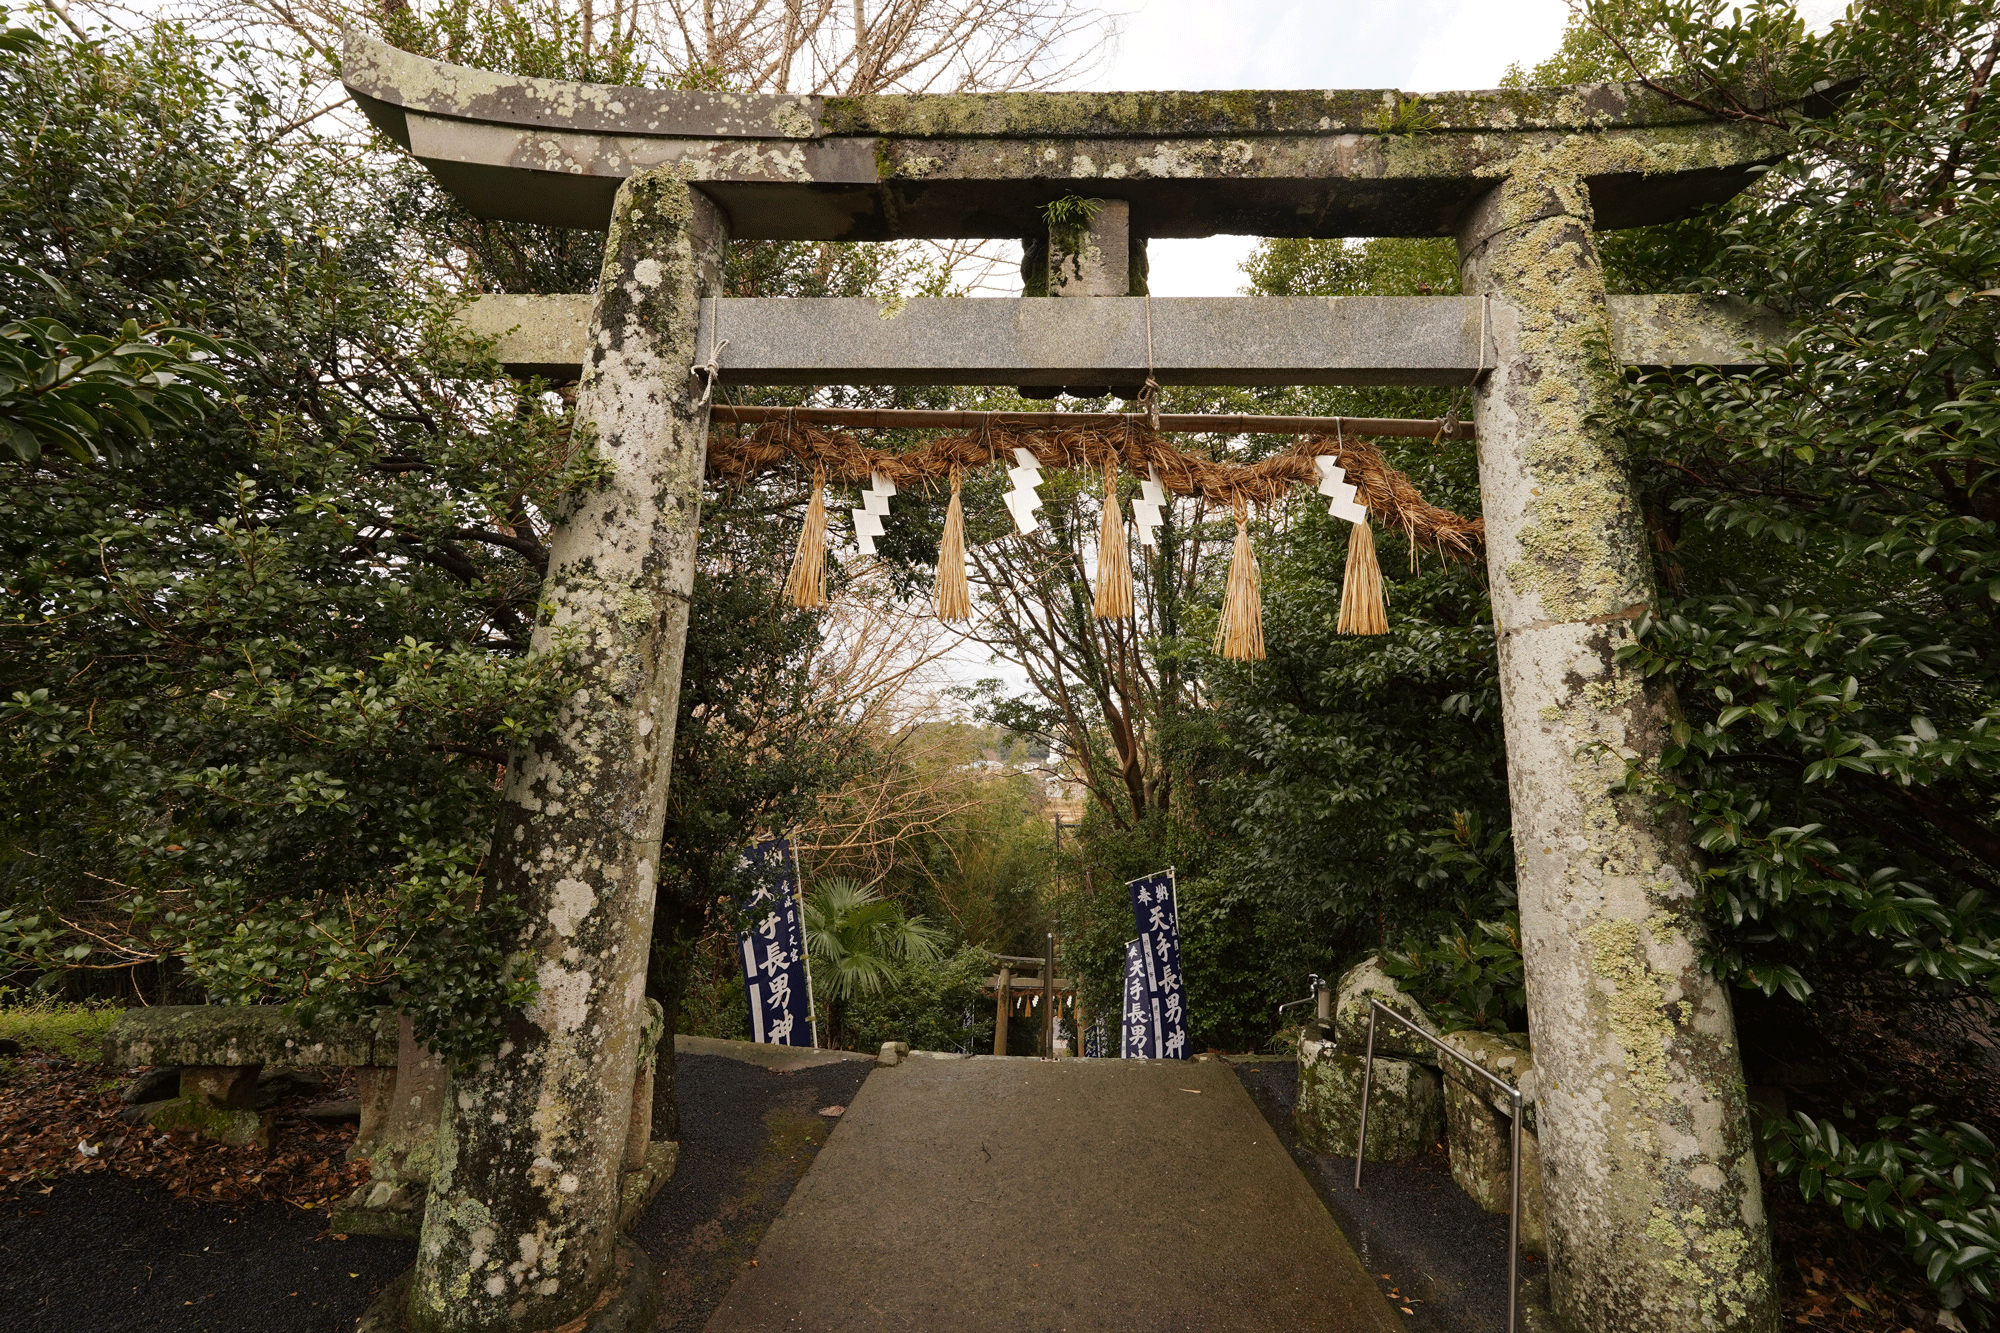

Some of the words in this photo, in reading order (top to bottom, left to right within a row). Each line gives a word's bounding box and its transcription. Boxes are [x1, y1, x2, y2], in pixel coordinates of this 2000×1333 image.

[1137, 883, 1169, 906] 奉納
[1149, 905, 1186, 1060] 天手長男神
